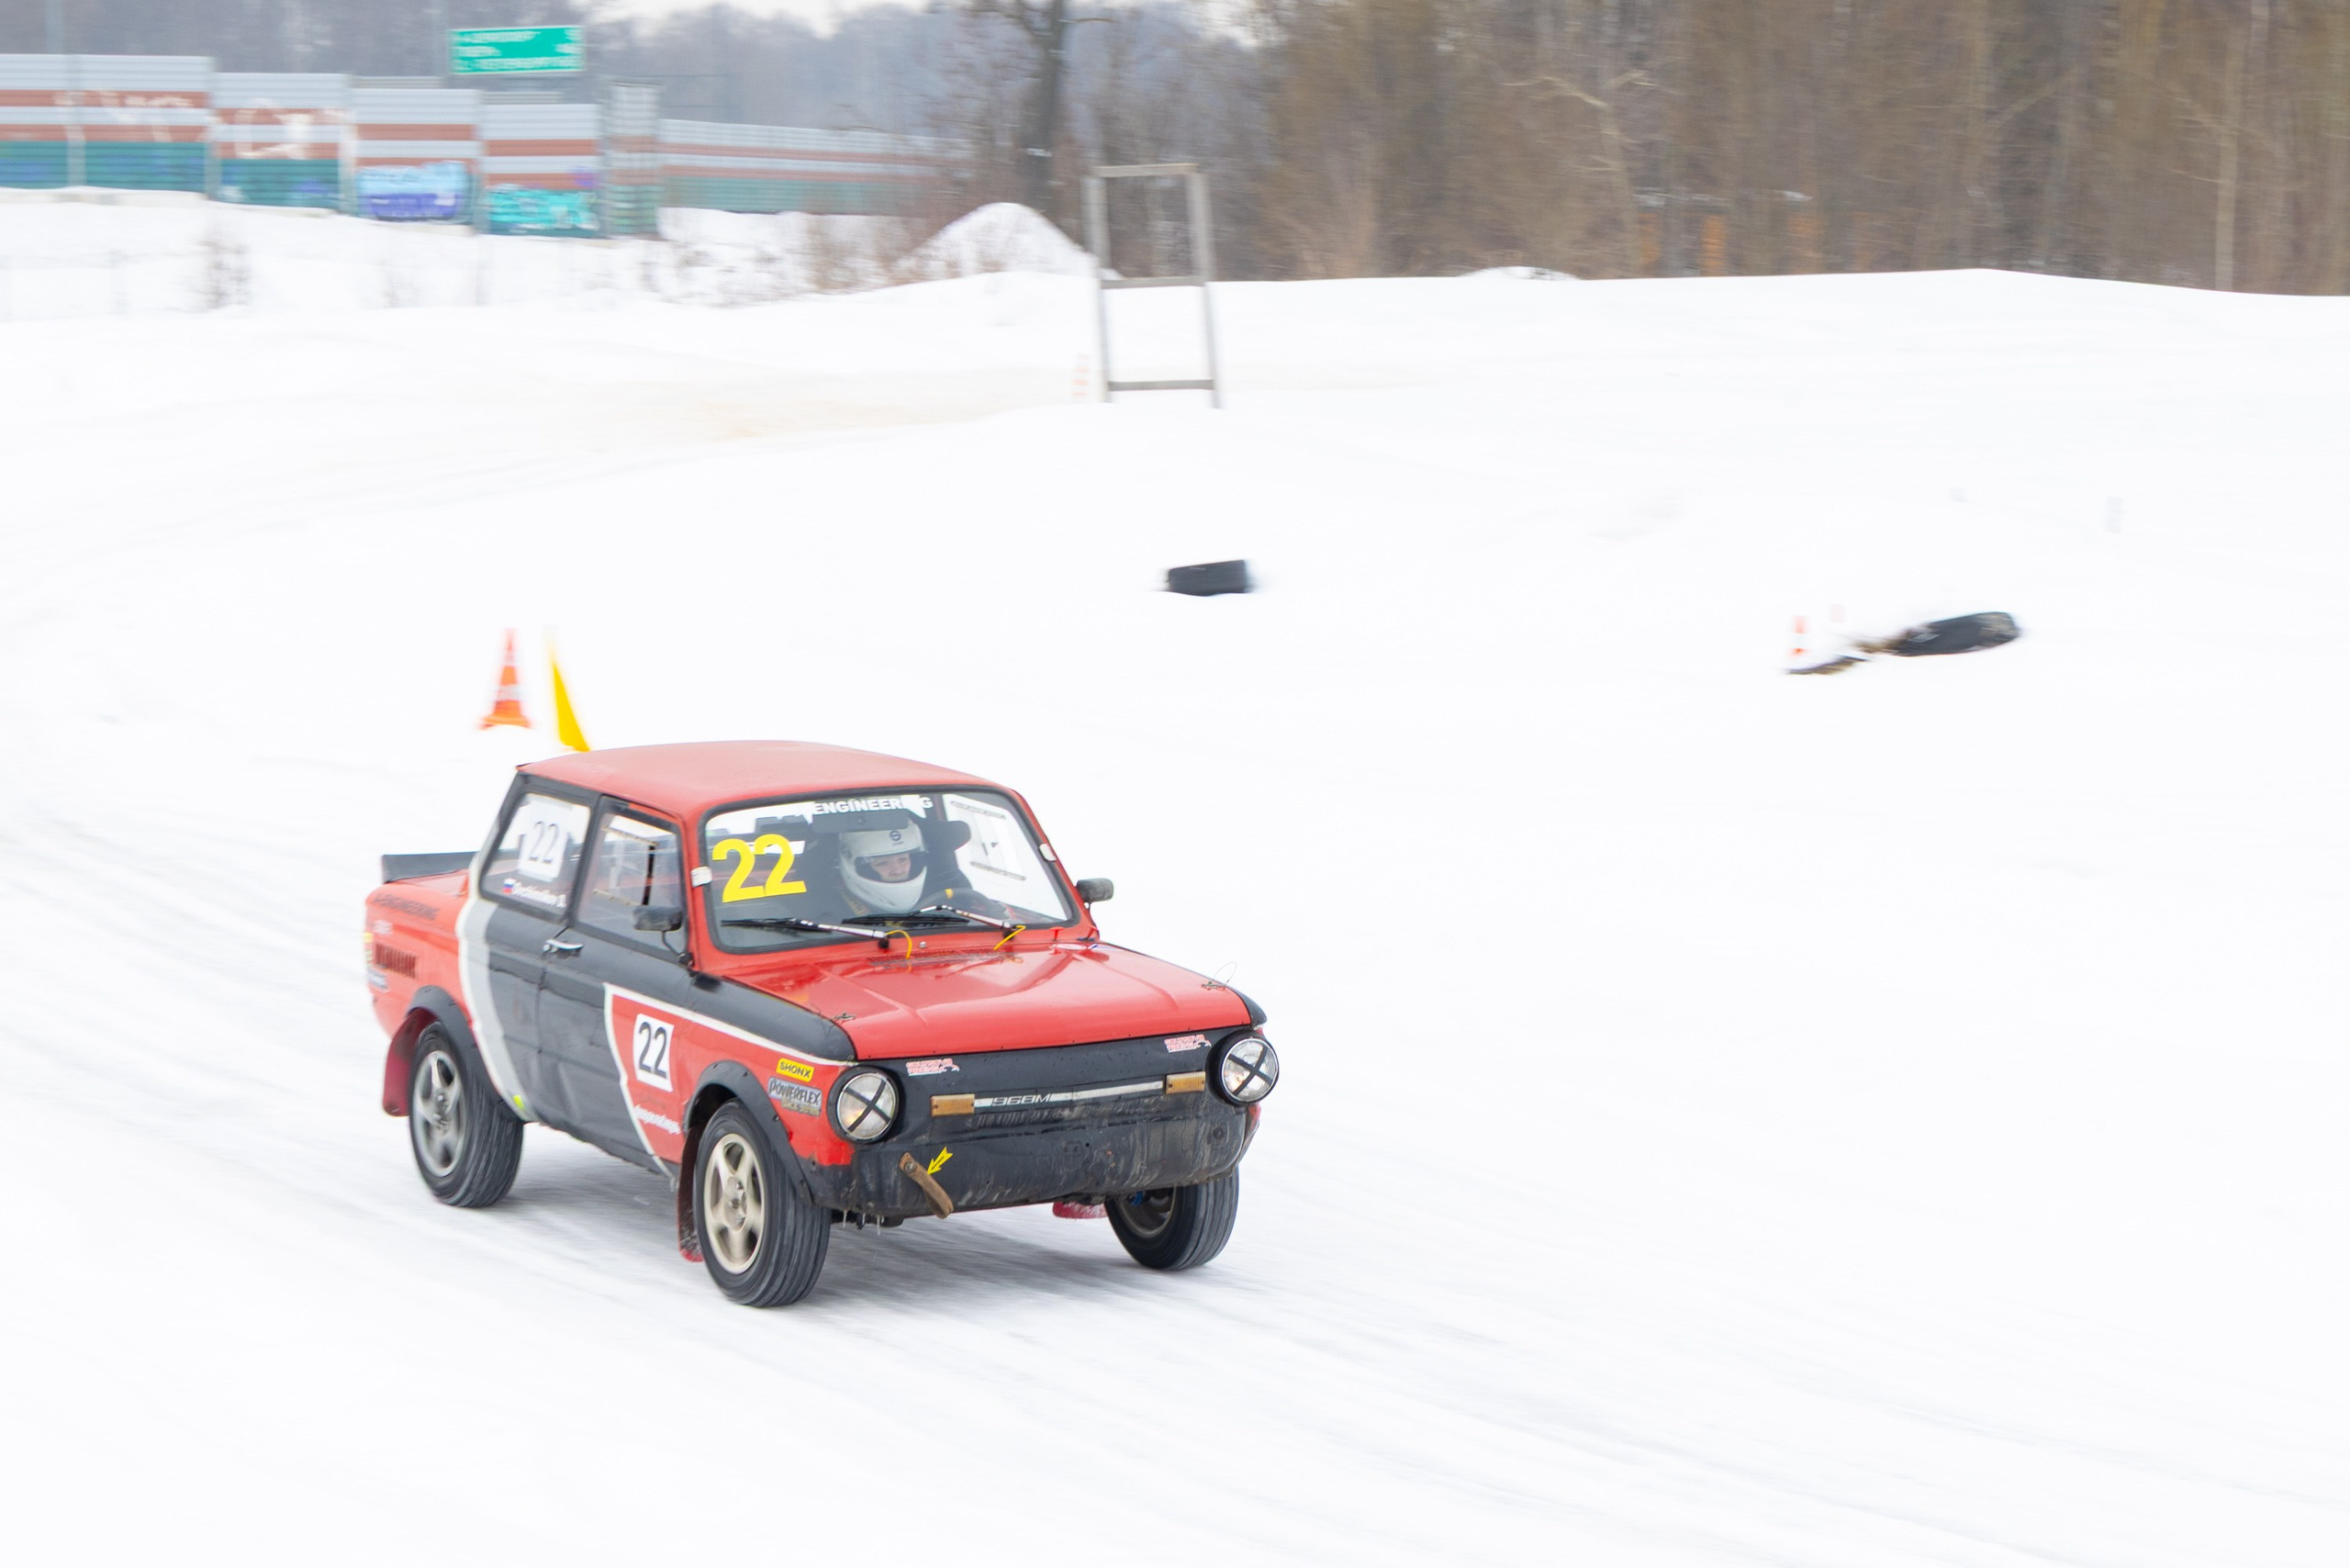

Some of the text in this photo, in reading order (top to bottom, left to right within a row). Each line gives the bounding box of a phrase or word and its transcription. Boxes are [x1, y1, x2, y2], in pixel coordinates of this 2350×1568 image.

[813, 796, 934, 815] ENGINEERG
[528, 821, 560, 864] 22
[711, 833, 808, 904] 22
[639, 1021, 667, 1080] 22
[780, 1061, 811, 1079] SHONX
[769, 1078, 821, 1105] POWERFLEX
[991, 1093, 1051, 1107] 968M
